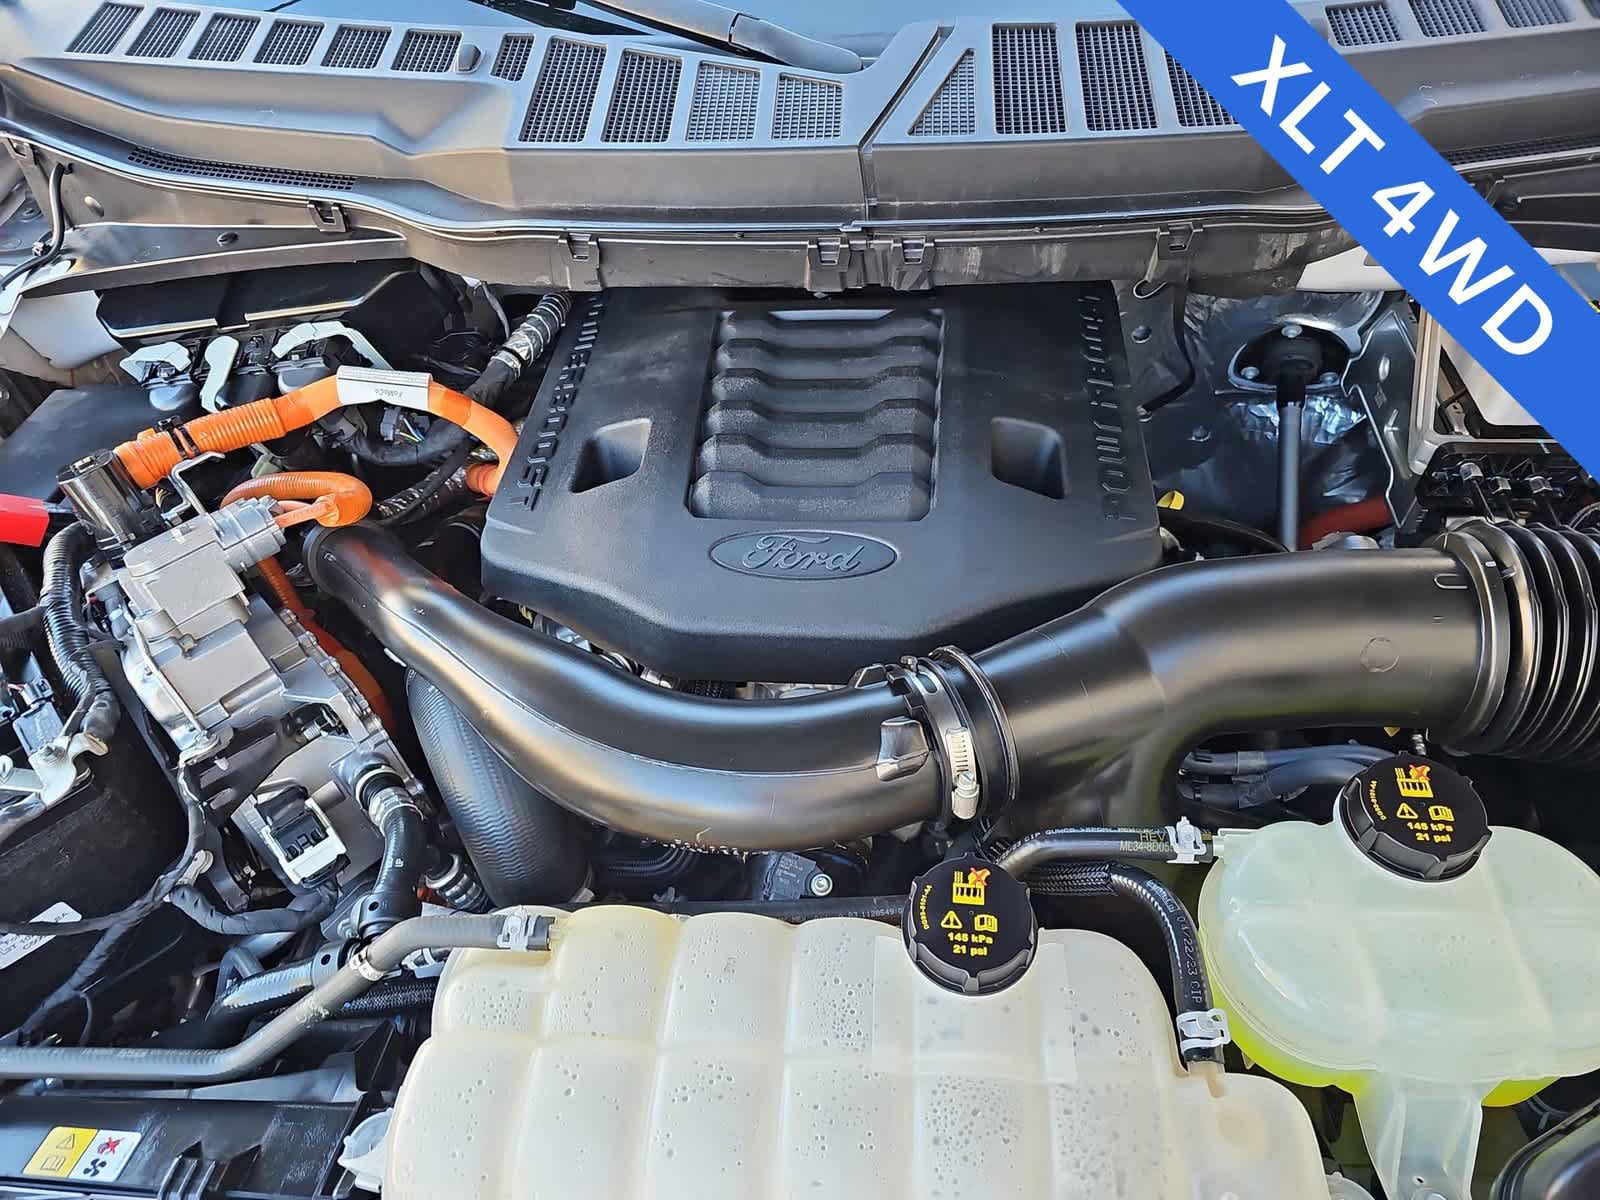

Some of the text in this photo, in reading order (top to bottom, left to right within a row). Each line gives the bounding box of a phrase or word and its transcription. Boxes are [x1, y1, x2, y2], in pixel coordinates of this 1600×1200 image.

[741, 534, 866, 573] Ford
[1406, 821, 1454, 832] 145 kPa
[1139, 832, 1166, 842] HEV
[1415, 832, 1452, 843] 21 psi
[1119, 840, 1173, 853] ML34-8D05
[947, 932, 994, 945] 145 kPa
[952, 944, 988, 957] 21 psi
[1189, 981, 1203, 1004] CIP
